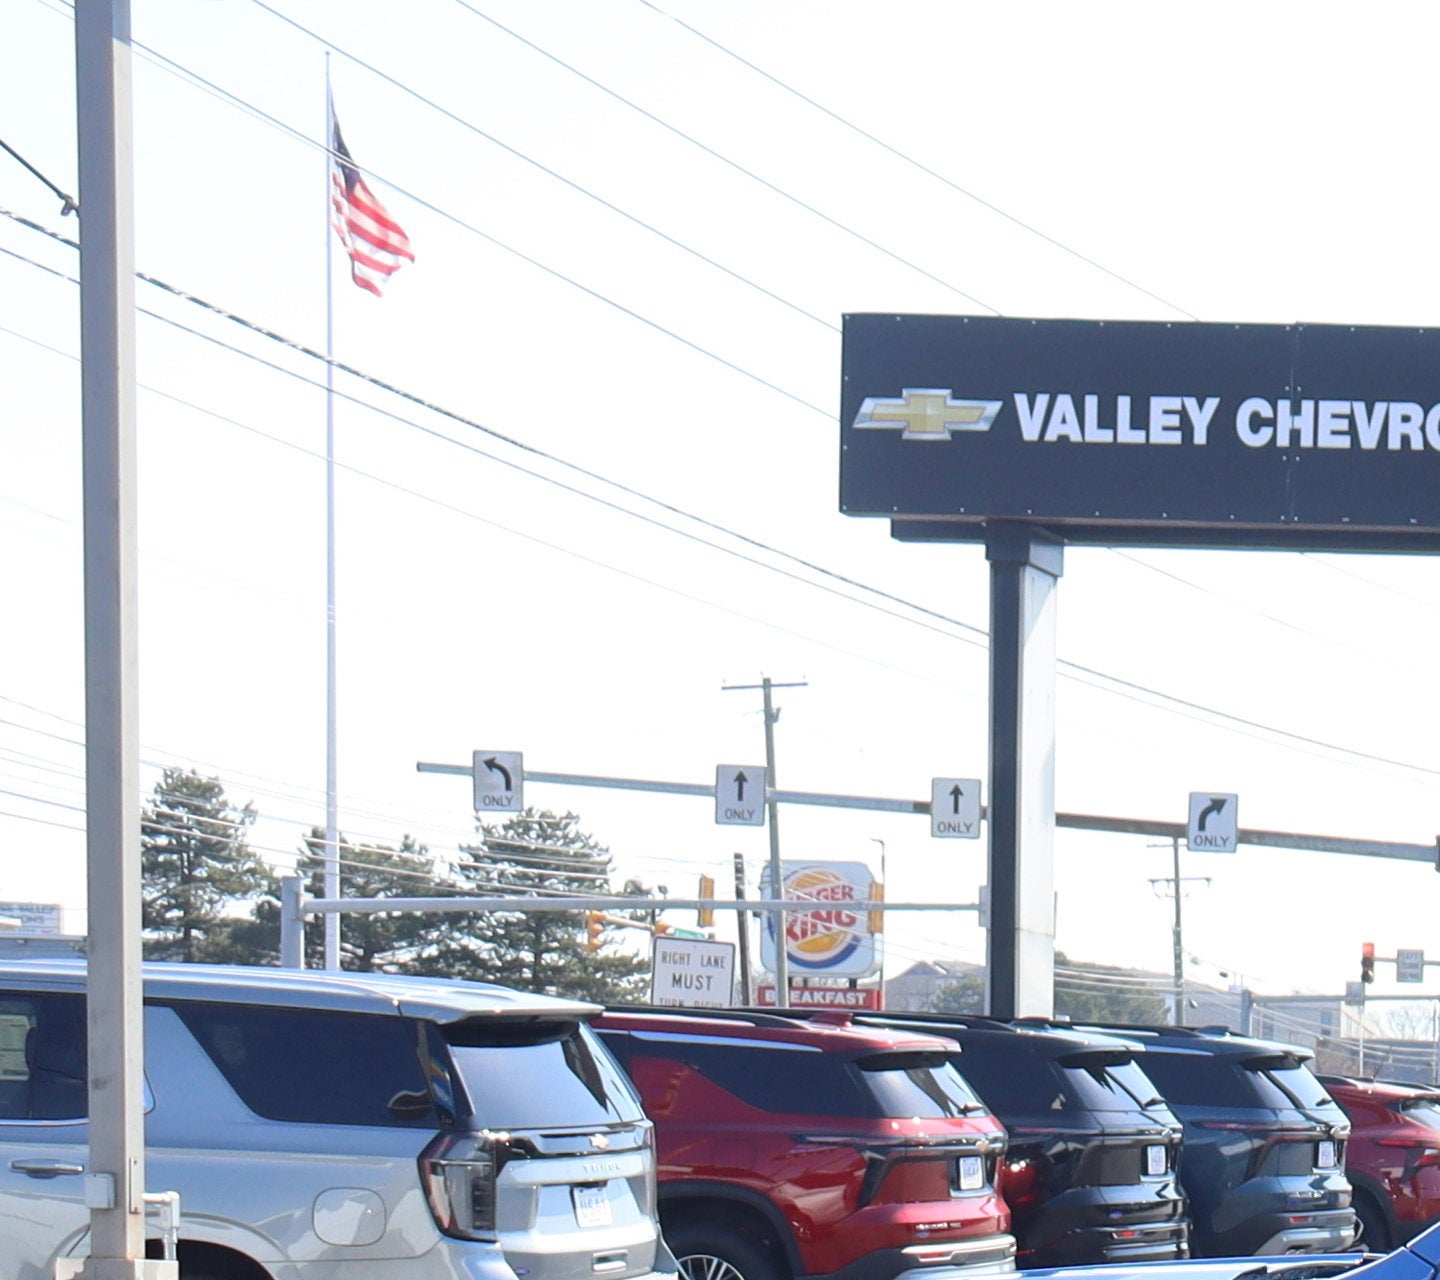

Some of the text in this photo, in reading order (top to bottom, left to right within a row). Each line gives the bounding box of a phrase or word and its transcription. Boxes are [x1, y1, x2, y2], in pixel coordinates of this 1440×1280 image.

[1013, 393, 1222, 446] VALLEY
[483, 794, 514, 807] ONLY
[724, 808, 756, 820] ONLY
[937, 821, 973, 834] ONLY
[1193, 835, 1229, 848] ONLY
[661, 950, 726, 970] RIGHT LANE
[672, 974, 714, 992] MUST
[765, 989, 866, 1005] BEAKFAST
